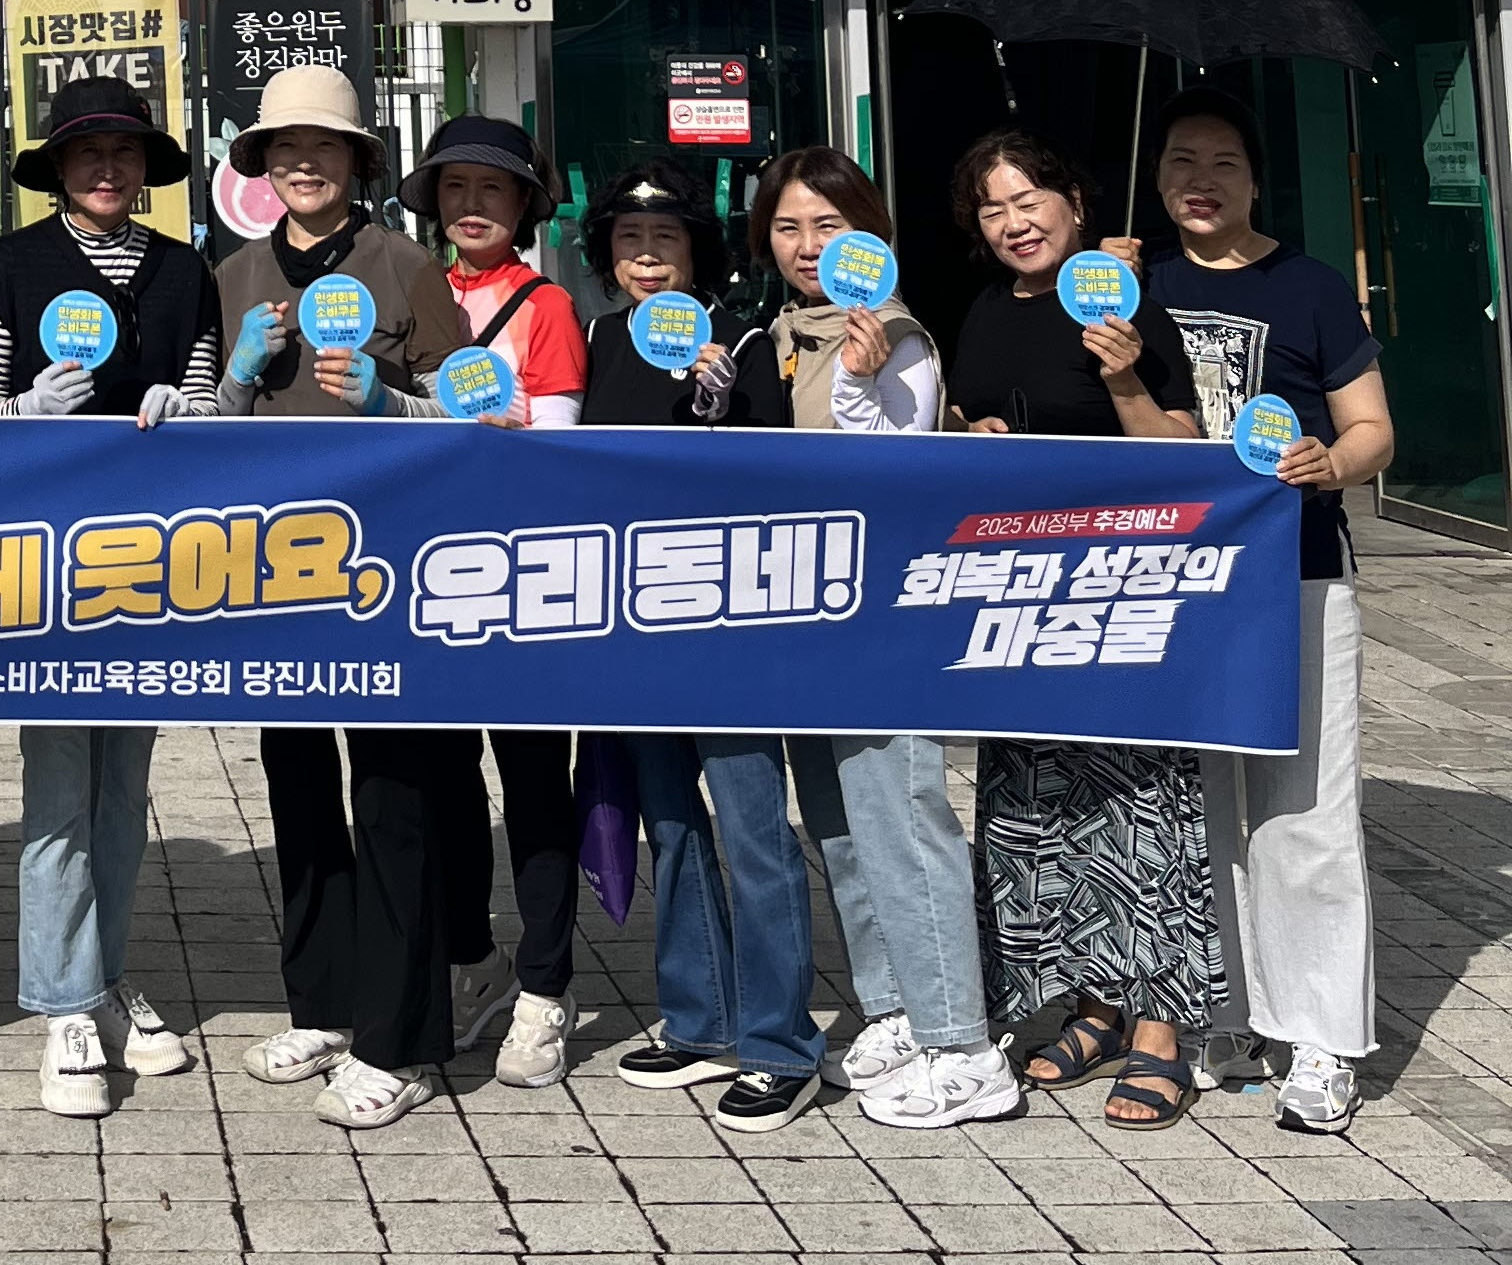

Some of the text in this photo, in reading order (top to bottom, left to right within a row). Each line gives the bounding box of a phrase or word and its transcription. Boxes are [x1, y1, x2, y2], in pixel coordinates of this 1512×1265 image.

[20, 9, 163, 46] 시장맛집#
[232, 10, 346, 43] 좋은원두
[39, 53, 151, 93] TAKE
[976, 507, 1179, 537] 2025 새정부 추경예산
[63, 500, 394, 631] 웃어요,
[410, 524, 615, 646] 우리
[623, 510, 865, 632] 동네!
[890, 543, 1246, 607] 회복과 성장의
[941, 598, 1187, 671] 마중물
[241, 660, 402, 697] 당진시지회
